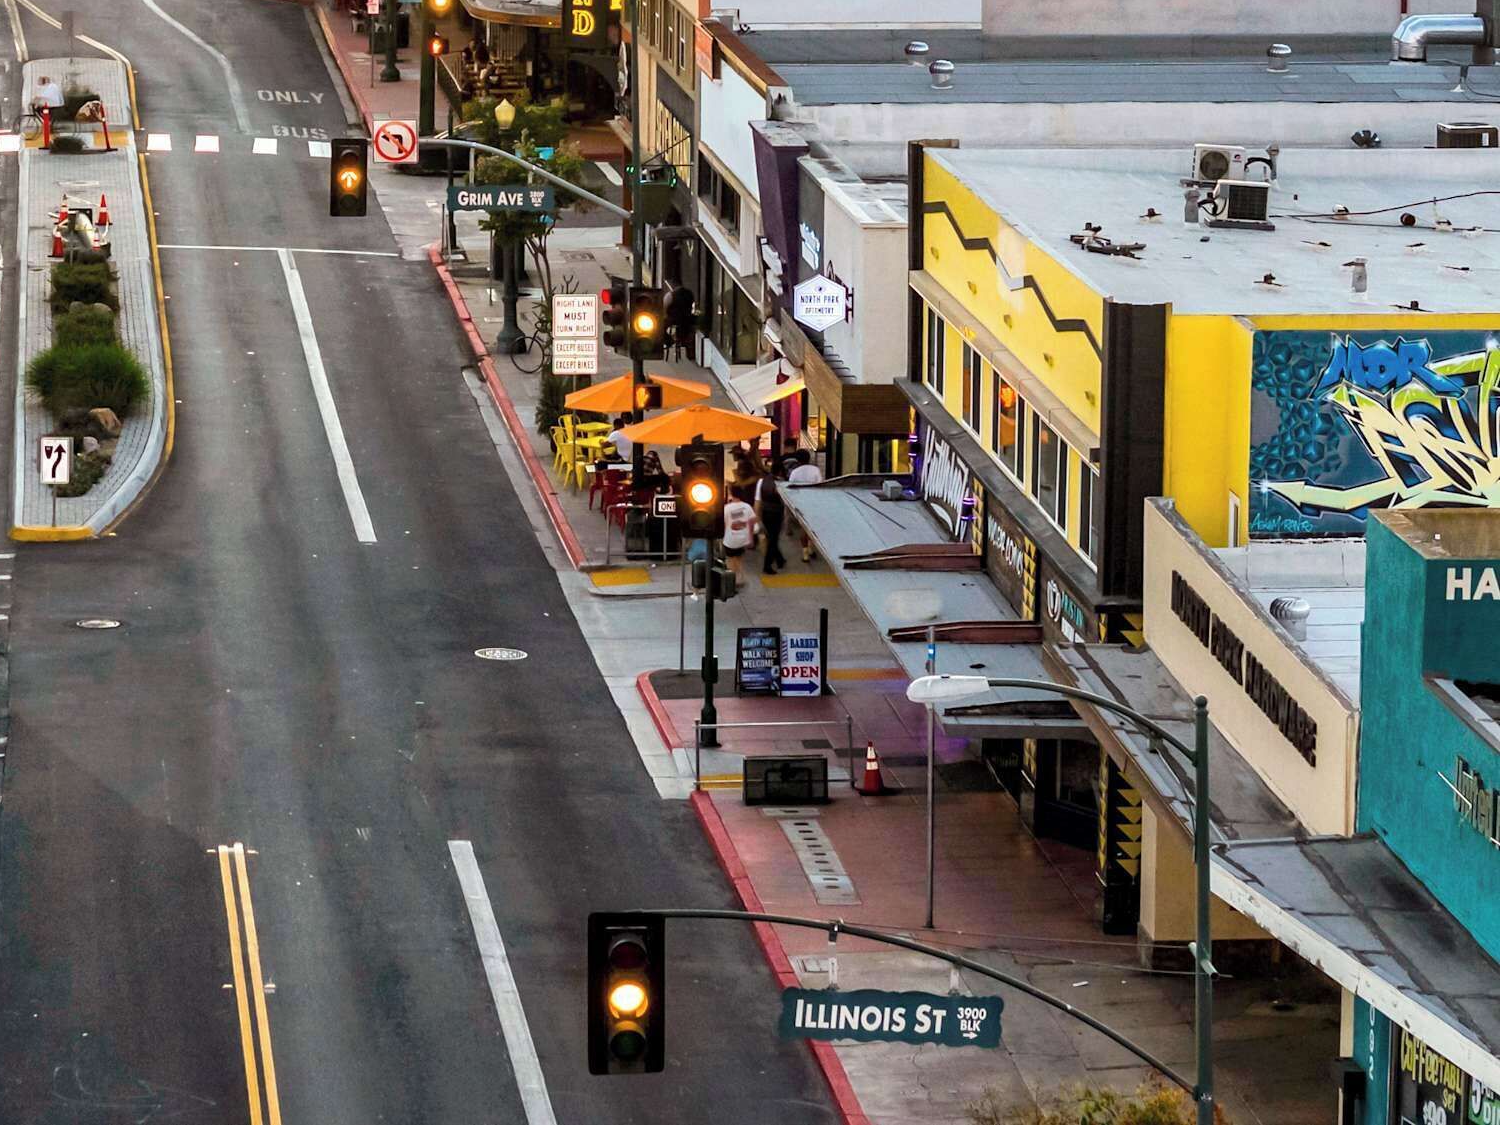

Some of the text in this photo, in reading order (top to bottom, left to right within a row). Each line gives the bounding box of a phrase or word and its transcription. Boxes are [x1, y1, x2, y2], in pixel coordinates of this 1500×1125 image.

[257, 89, 325, 105] ONLY
[272, 124, 330, 140] BUS
[457, 190, 524, 206] GRIM AVE
[556, 300, 593, 308] RIGHT LANE
[801, 295, 839, 304] NORTH PARK
[564, 312, 587, 321] MUST
[556, 325, 594, 333] TURN RIGHT
[556, 343, 595, 352] EXCEPT BUSES
[555, 360, 595, 369] EXCEPT BIKES
[790, 638, 819, 649] BARBER
[795, 651, 815, 662] SHOP
[742, 659, 775, 669] WELCOME
[1171, 569, 1318, 768] NORTH PARK HARDWARE
[782, 666, 819, 678] OPEN
[794, 998, 948, 1034] ILLINOIS ST
[956, 1007, 988, 1020] 3900
[959, 1020, 981, 1032] BLK
